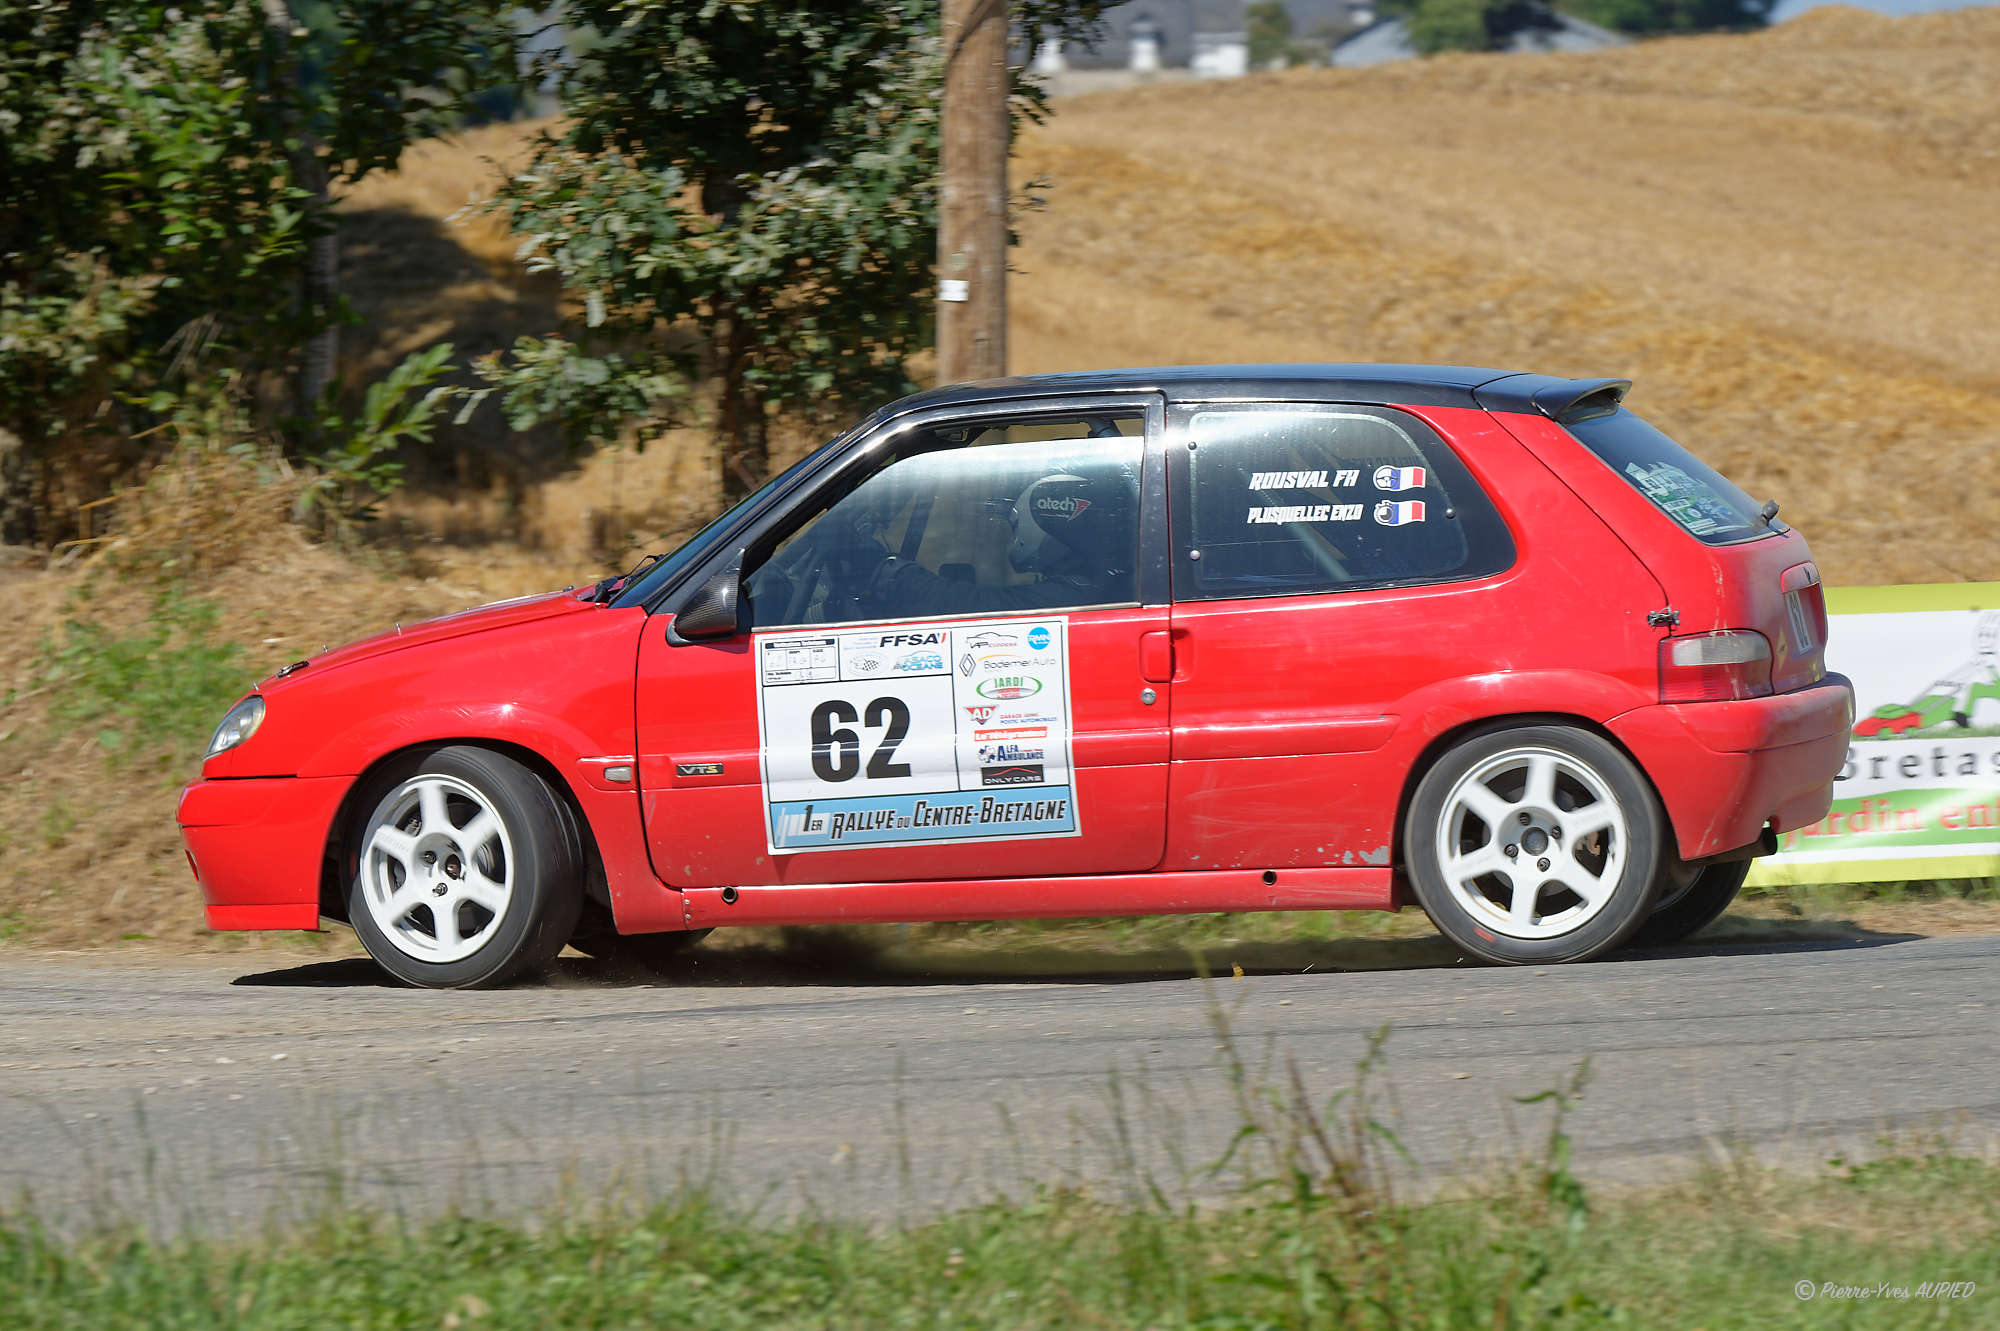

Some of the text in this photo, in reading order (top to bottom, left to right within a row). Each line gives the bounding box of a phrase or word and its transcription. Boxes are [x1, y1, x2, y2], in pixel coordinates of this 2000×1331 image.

[1248, 470, 1329, 491] ROUSVAL
[1037, 497, 1075, 512] atech
[1247, 504, 1364, 526] PLUSQUELLEC ENZO
[879, 633, 939, 648] FFSA
[973, 707, 992, 720] AD
[811, 696, 912, 783] 62
[680, 765, 718, 774] VTS
[984, 775, 1041, 785] ONLY CARS
[831, 809, 896, 840] RALLYE
[896, 816, 911, 829] DU
[912, 797, 1068, 827] CENTRE-BRETAGNE
